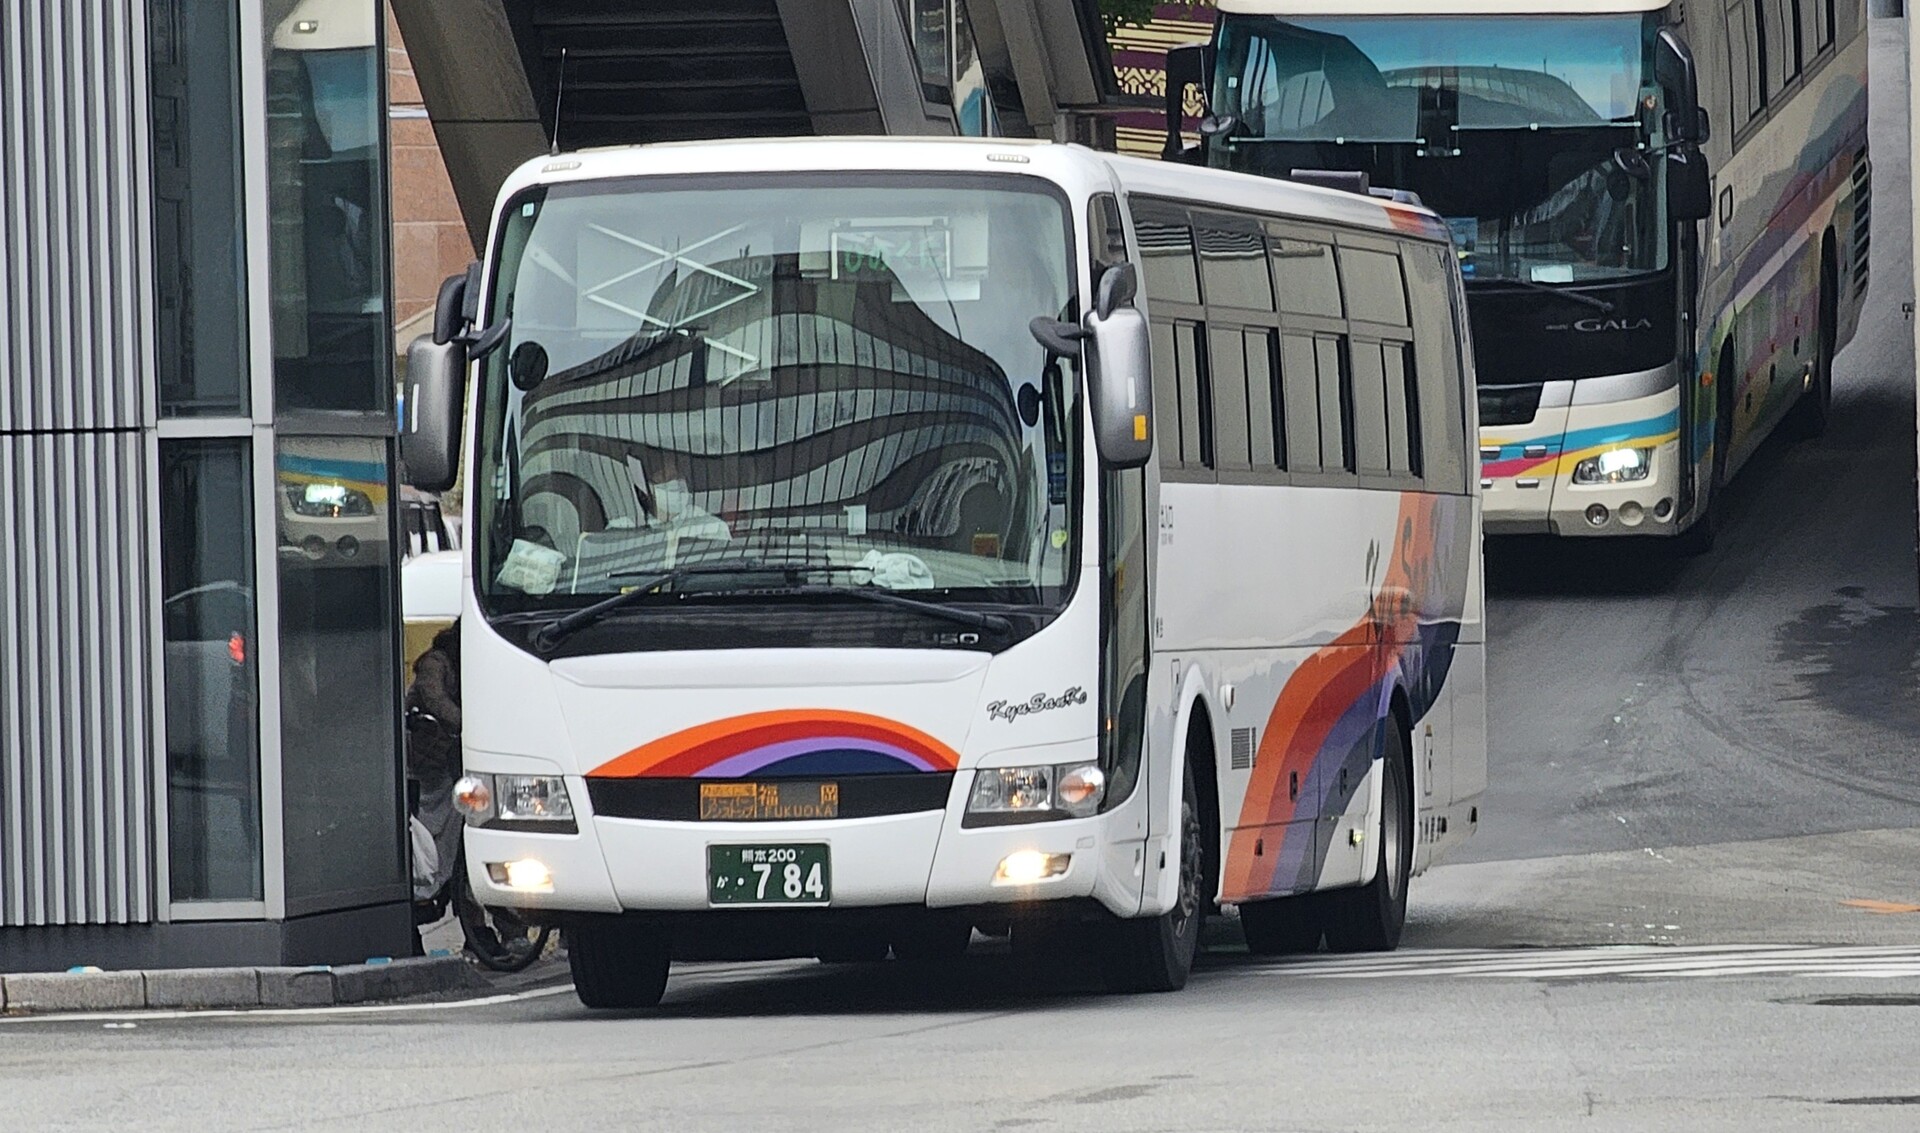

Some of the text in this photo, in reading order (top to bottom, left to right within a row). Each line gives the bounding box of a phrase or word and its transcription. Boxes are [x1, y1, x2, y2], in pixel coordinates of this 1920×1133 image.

[1574, 318, 1652, 332] GALA
[986, 686, 1087, 723] KyuSanKo
[763, 804, 834, 817] FUKUOKA
